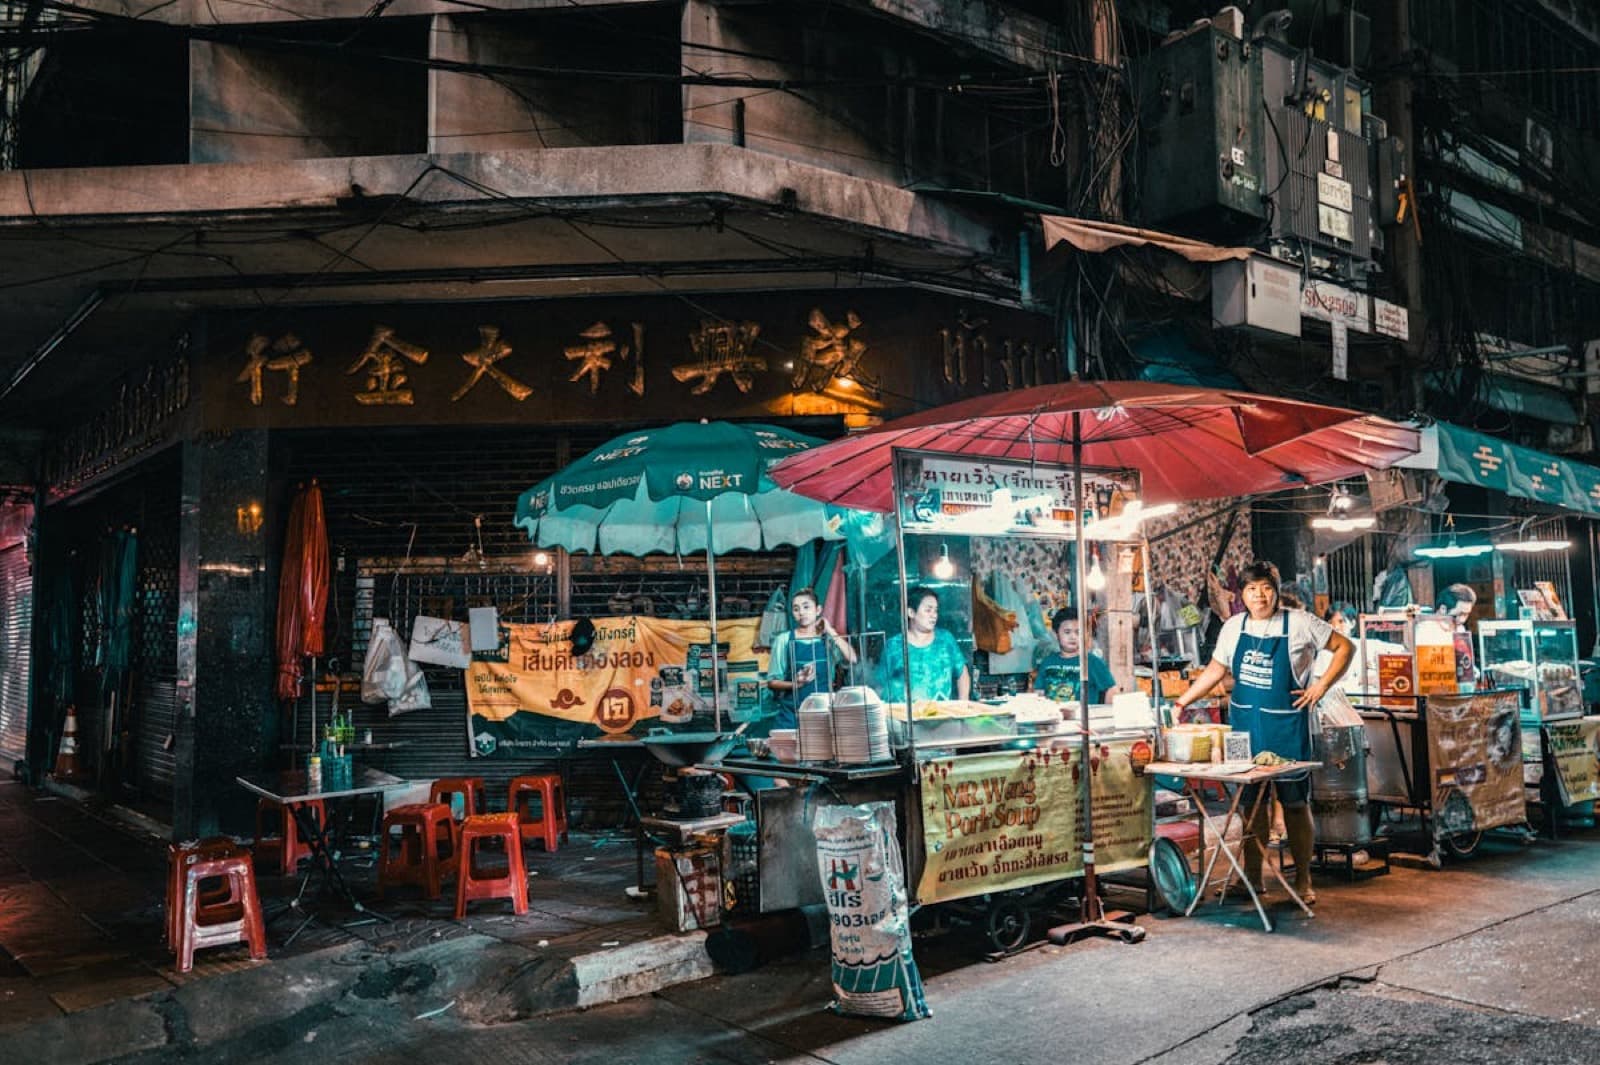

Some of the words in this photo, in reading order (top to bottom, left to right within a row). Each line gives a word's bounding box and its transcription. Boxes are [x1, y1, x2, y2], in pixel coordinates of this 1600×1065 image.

[593, 446, 648, 462] NEXT
[699, 473, 743, 490] NEXT
[945, 807, 992, 838] Pork
[992, 803, 1041, 831] Soup
